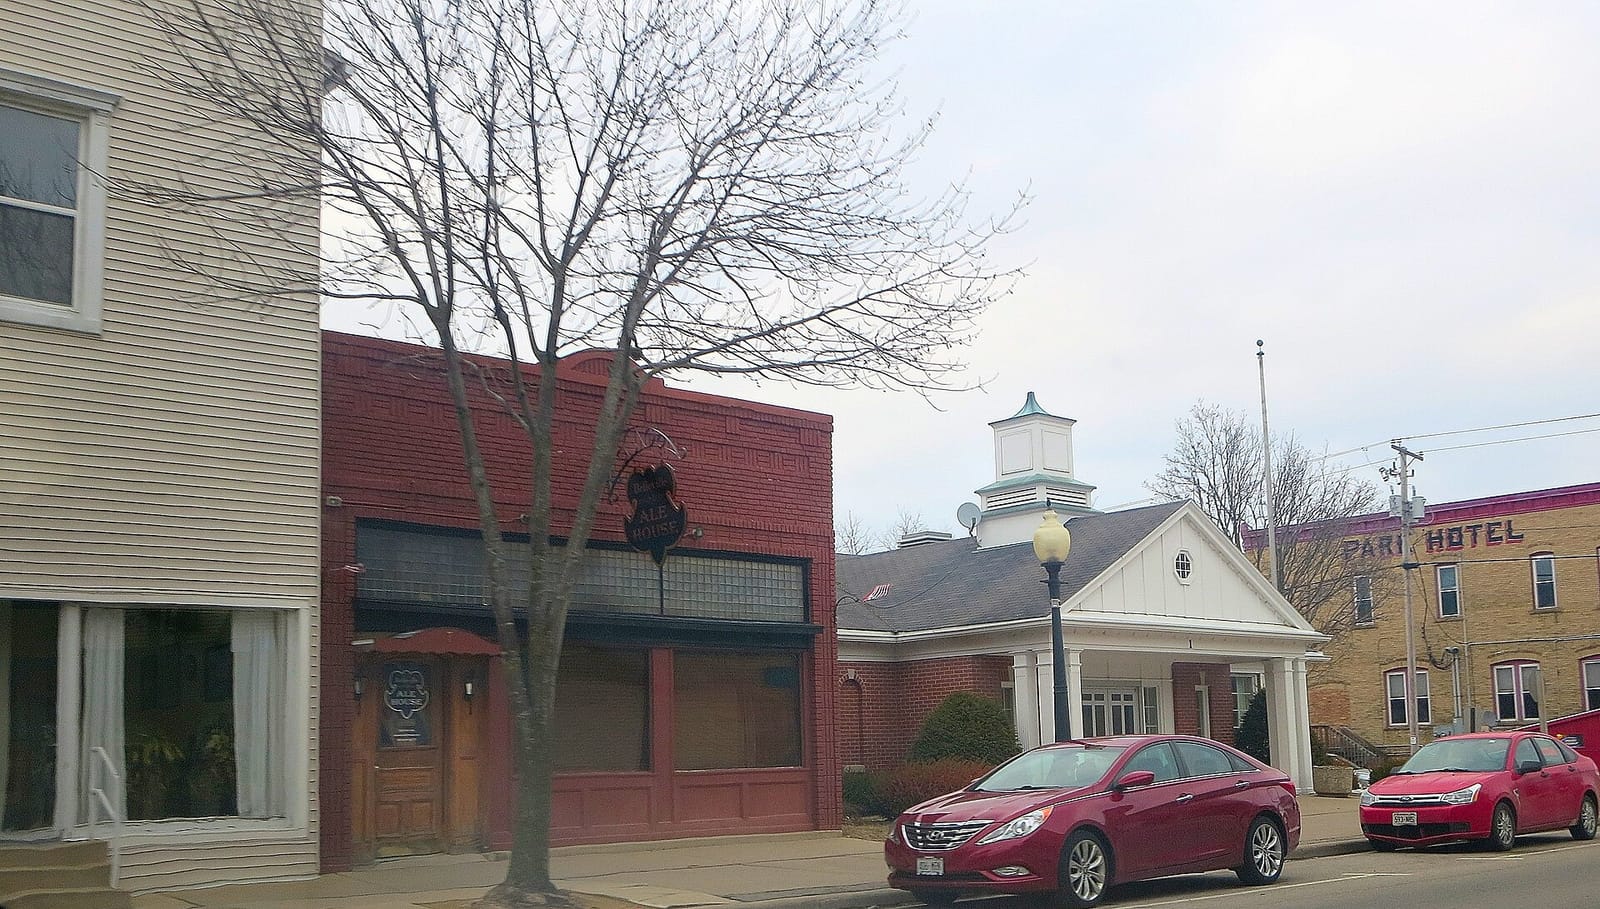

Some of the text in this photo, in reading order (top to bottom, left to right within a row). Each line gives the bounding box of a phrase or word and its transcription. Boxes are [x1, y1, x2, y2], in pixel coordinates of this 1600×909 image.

[640, 505, 668, 522] ALE
[632, 520, 679, 538] HOUSE
[1426, 519, 1524, 553] HOTEL
[390, 698, 423, 706] HOUSE
[396, 690, 417, 698] ALE
